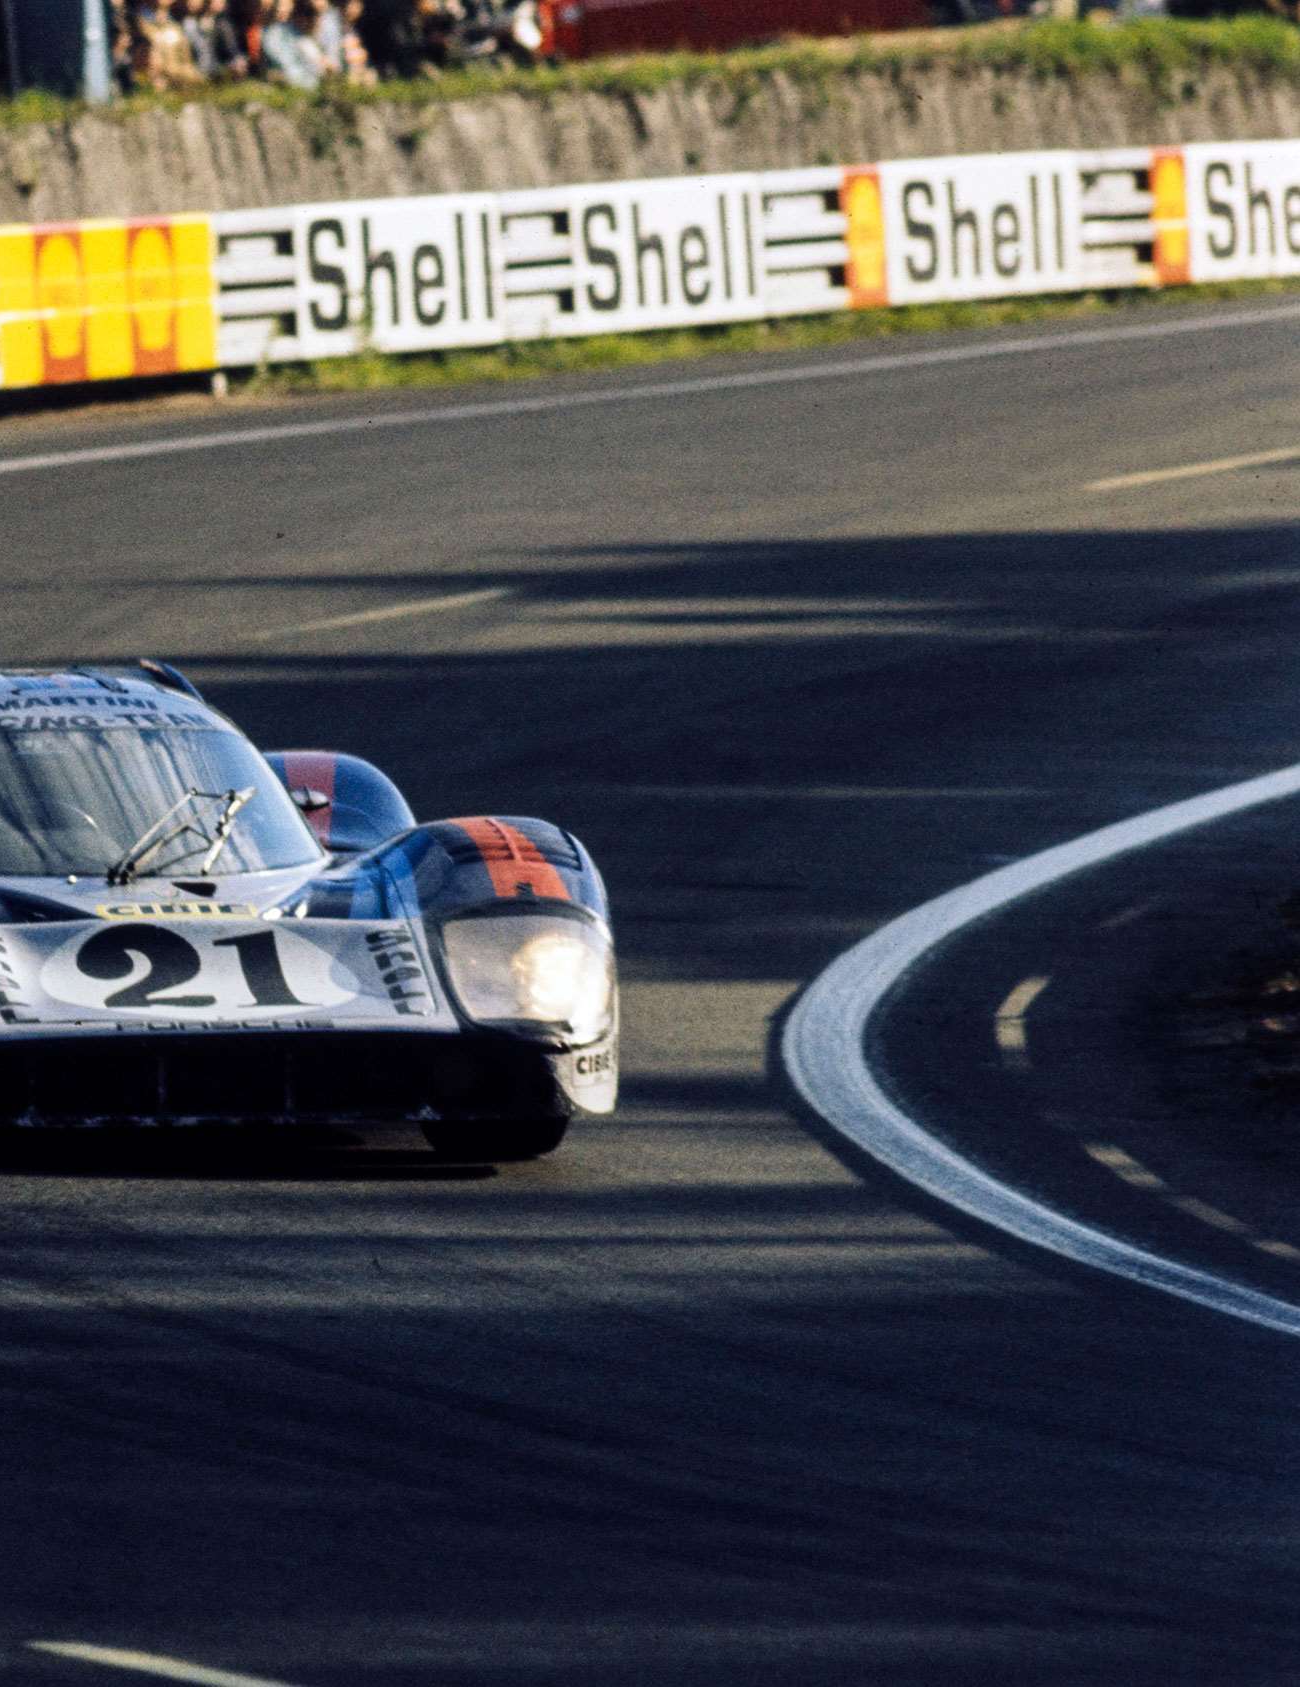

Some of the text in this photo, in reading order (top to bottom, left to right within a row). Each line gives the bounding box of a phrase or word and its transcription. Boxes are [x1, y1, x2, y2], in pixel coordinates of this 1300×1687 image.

[307, 211, 495, 331] Shell
[583, 192, 756, 312] Shell
[902, 172, 1066, 284] Shell
[77, 922, 324, 1009] 21
